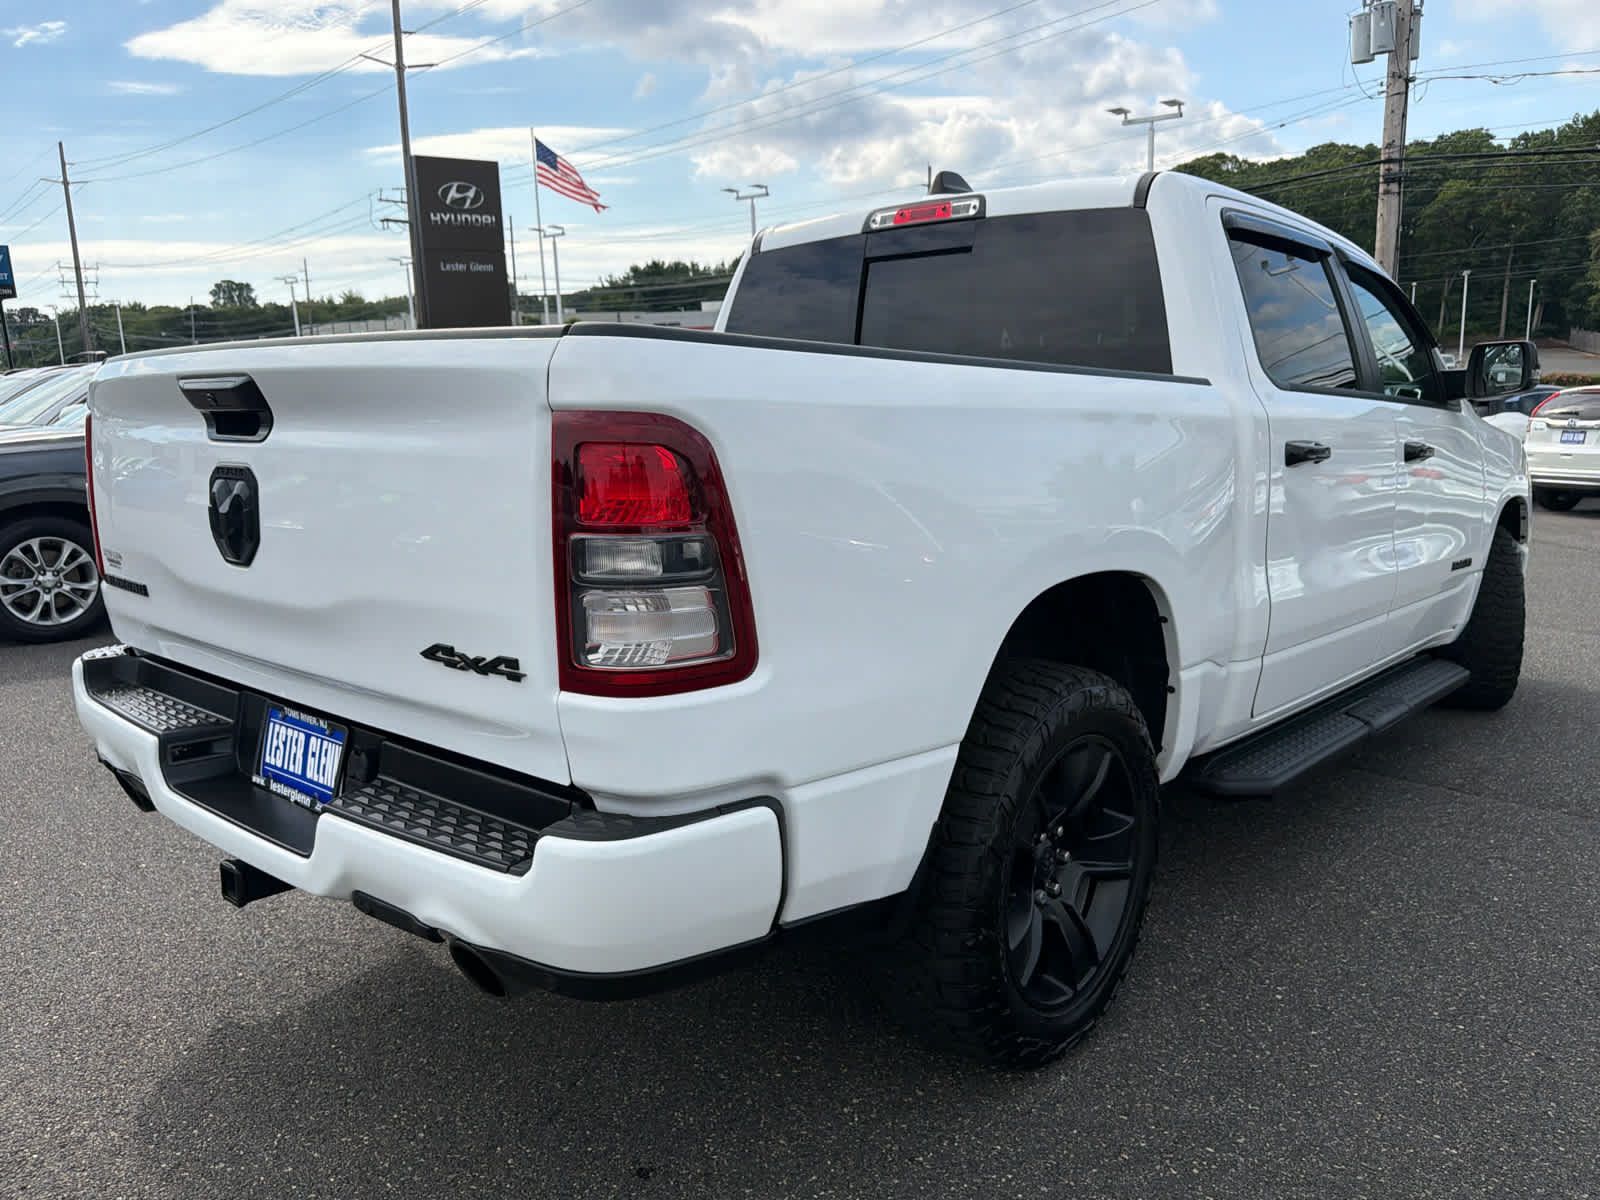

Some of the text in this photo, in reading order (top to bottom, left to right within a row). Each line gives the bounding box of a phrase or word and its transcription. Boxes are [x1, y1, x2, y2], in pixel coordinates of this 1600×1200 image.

[430, 212, 496, 226] HYUNDAI
[440, 261, 494, 272] Lester Glenn
[265, 722, 343, 789] LESTER GLENN
